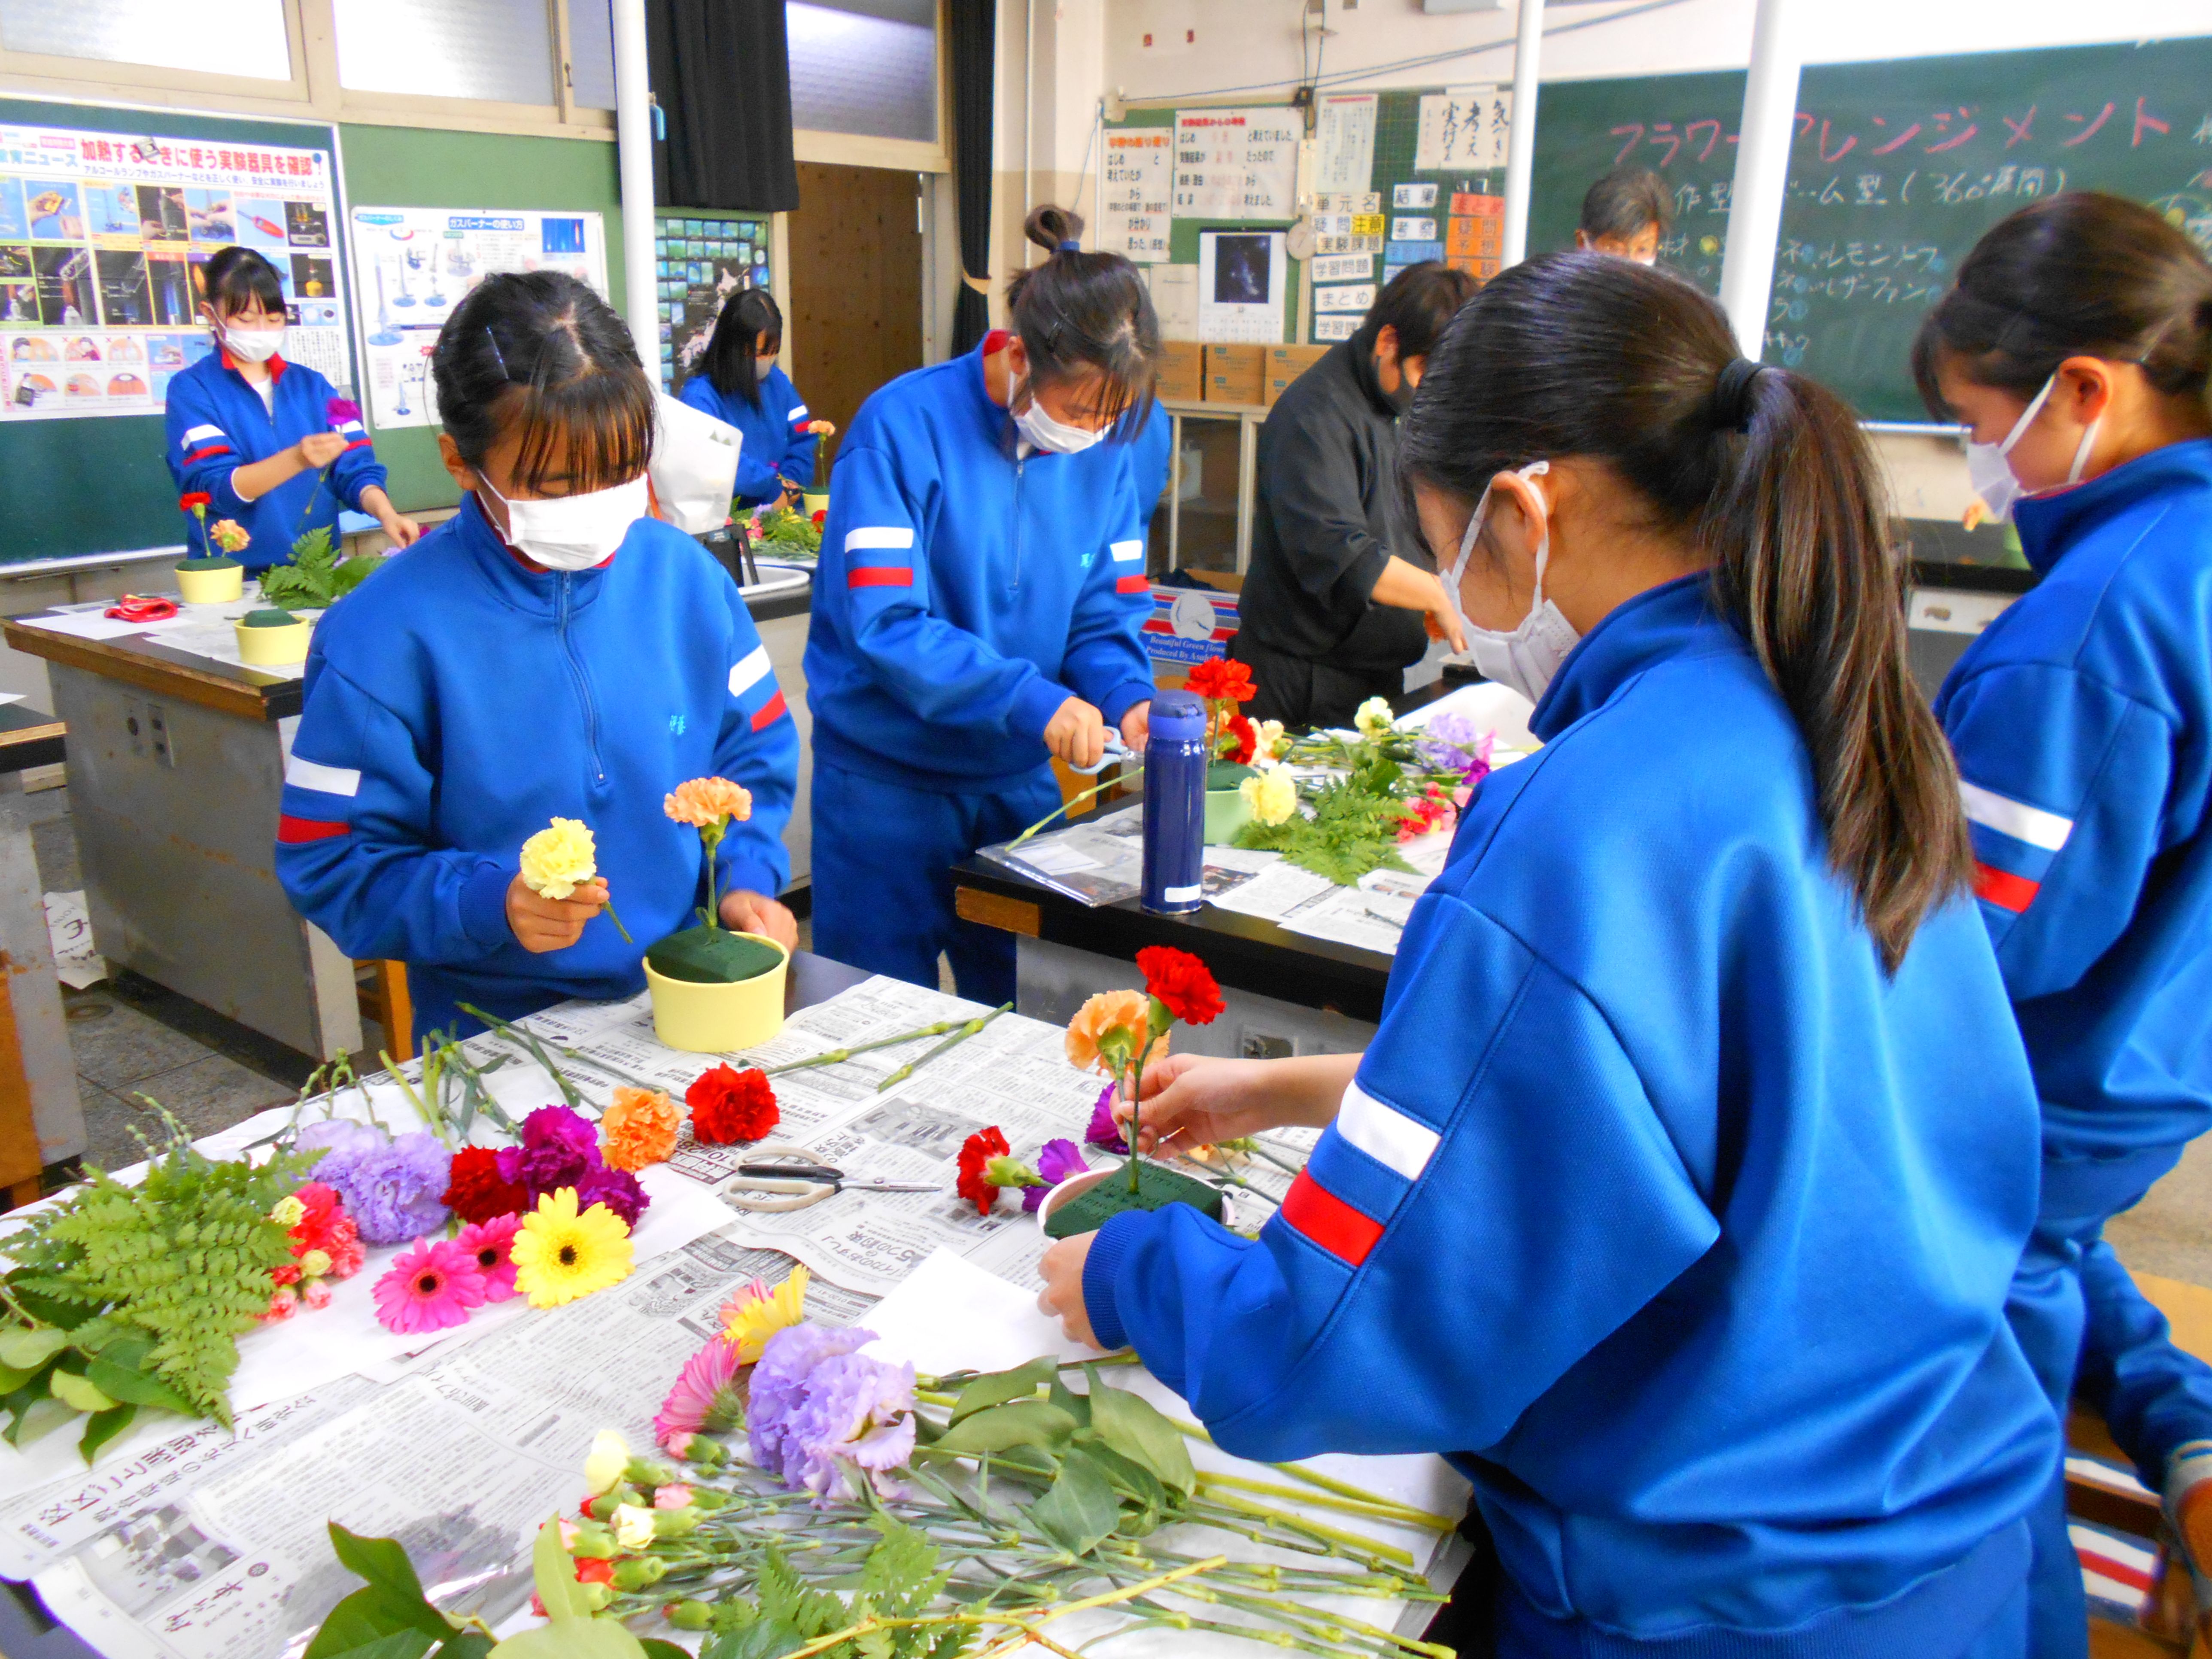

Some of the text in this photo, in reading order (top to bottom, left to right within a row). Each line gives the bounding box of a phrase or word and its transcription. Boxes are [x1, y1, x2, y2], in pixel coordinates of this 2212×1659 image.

[1610, 95, 2171, 167] フラワレンジメント
[1317, 194, 1376, 212] 単元名
[1395, 187, 1434, 205] 結果
[450, 218, 524, 229] ガスバーナーの使い方
[1315, 216, 1350, 232] 疑問
[1351, 216, 1382, 234] 注意
[1396, 220, 1434, 238] 考察
[1321, 237, 1380, 251] 実験課題
[1315, 258, 1370, 277] 学習問題
[1322, 290, 1369, 306] まとめ
[1319, 321, 1358, 336] 学習課
[1151, 636, 1181, 649] Beautiful
[1182, 641, 1204, 650] Green
[821, 1236, 900, 1275] 「イカのおすし」
[846, 1231, 916, 1262] 5つの約束
